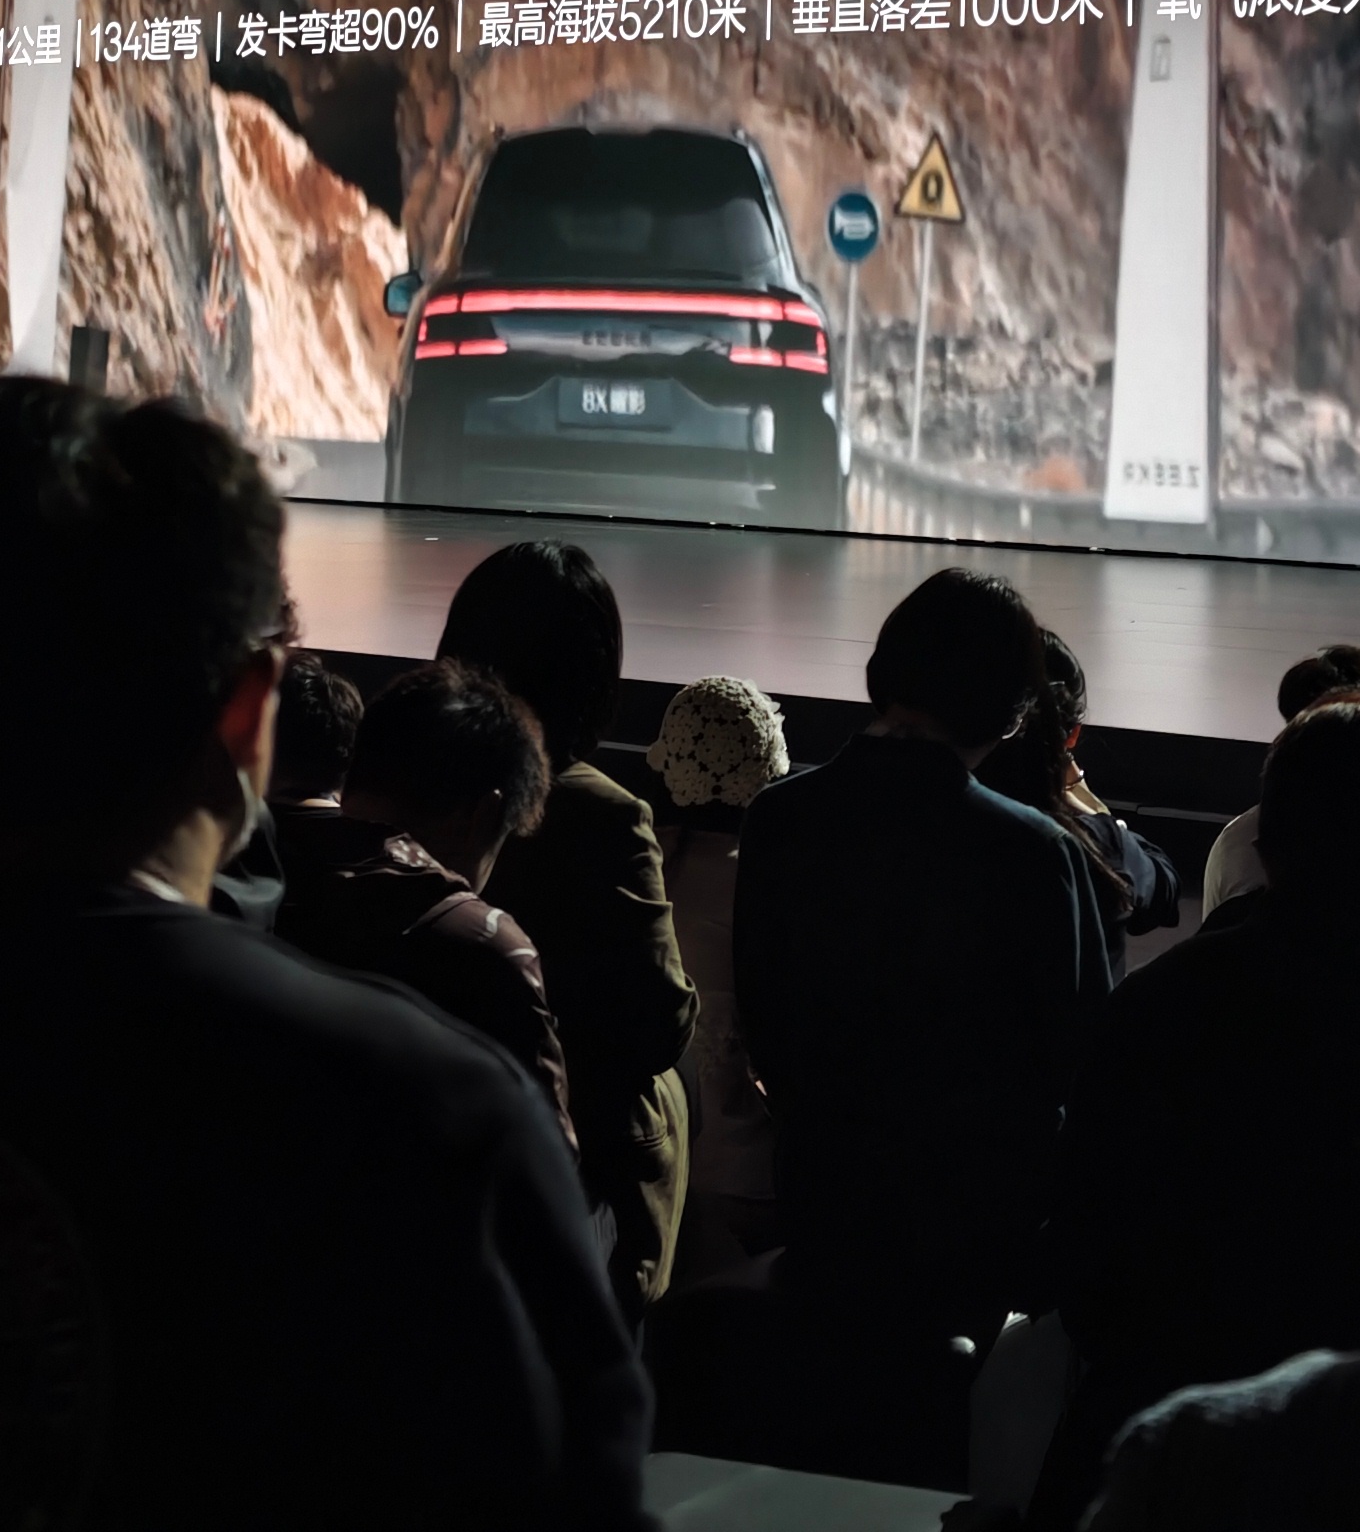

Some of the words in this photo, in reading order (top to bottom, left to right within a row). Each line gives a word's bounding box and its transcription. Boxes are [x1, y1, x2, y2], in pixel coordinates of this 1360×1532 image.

[90, 15, 202, 62] 134道弯
[236, 6, 439, 58] 发卡弯超90%
